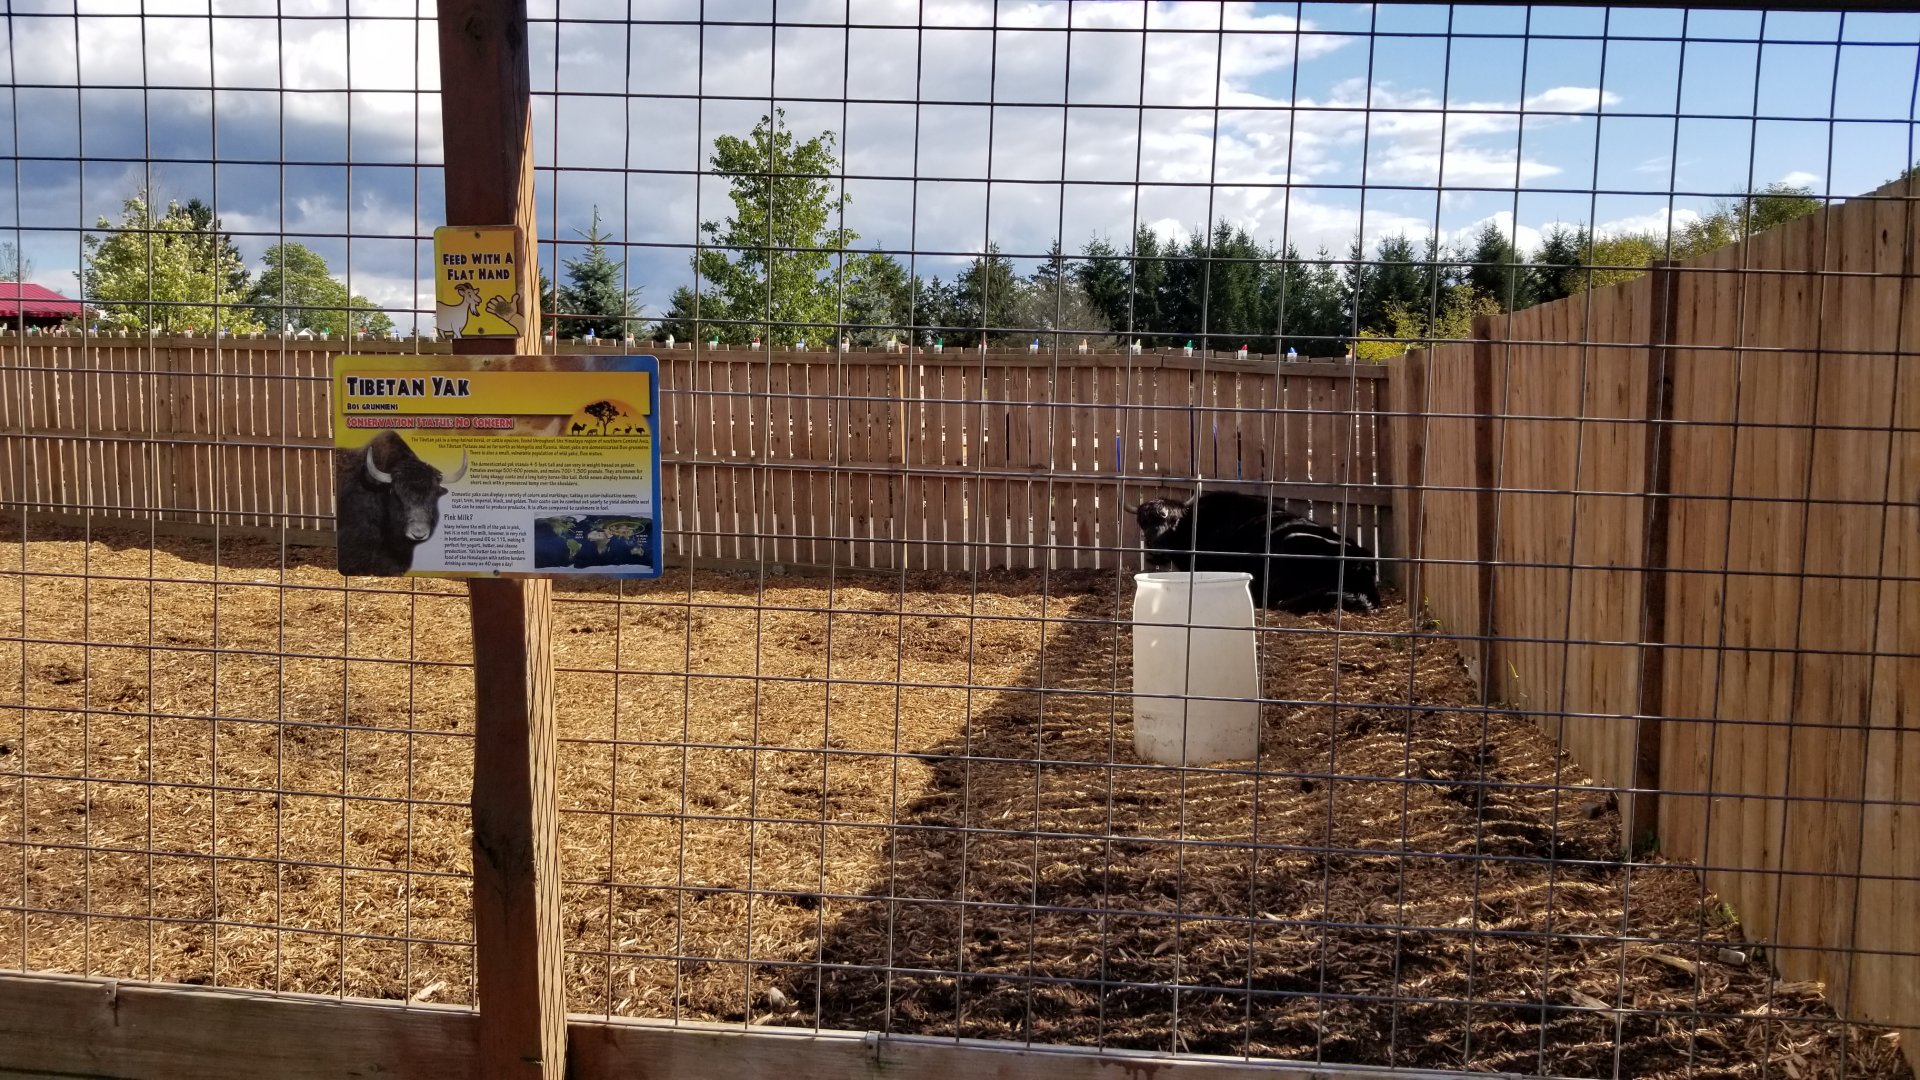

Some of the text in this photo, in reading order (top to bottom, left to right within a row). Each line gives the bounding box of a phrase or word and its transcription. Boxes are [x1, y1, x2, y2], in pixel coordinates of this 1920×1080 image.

[443, 252, 513, 265] FEED WITH A
[448, 268, 510, 280] FLAT HAND
[347, 377, 470, 396] TIBETAN YAK
[346, 417, 513, 428] CONSERVATION STATUS: NO CONCERN
